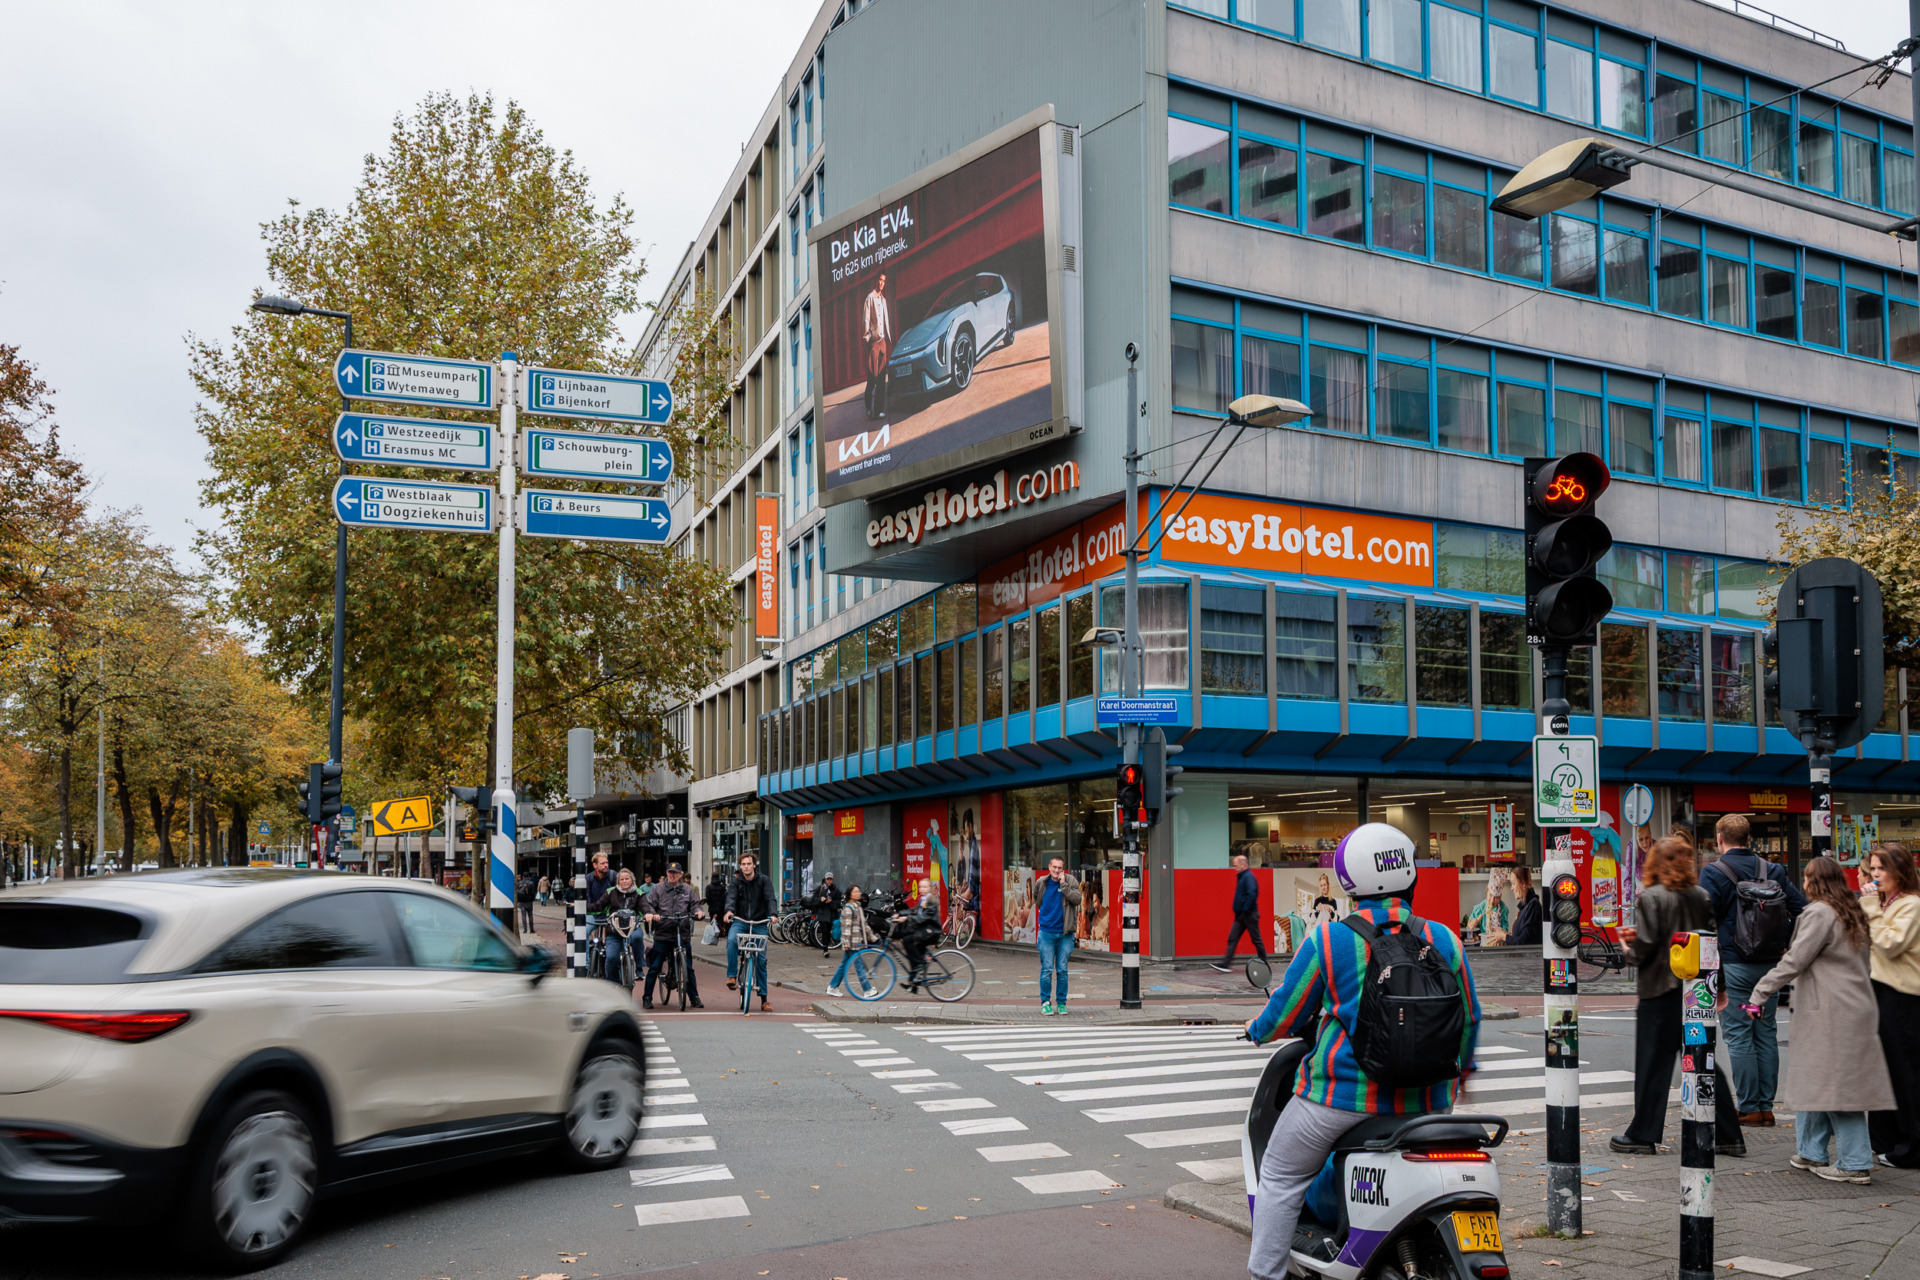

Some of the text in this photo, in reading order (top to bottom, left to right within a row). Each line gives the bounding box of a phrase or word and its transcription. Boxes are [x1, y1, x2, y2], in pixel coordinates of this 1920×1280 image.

[831, 205, 914, 264] De Kia EV4.
[831, 237, 908, 282] Tot 625 km rijbereik.
[402, 366, 478, 383] Museumpark
[387, 380, 459, 398] Wytemaweg
[558, 380, 606, 393] Lijnbaan
[558, 395, 611, 409] Bijenkorf
[387, 425, 462, 442] Westzeedijk
[1029, 425, 1053, 440] OCEAN
[383, 443, 434, 457] Erasmus
[438, 447, 456, 458] MC
[558, 440, 633, 458] Schouwburg-
[604, 461, 633, 471] plein
[839, 453, 891, 476] Movement that inspires
[387, 488, 452, 502] Westblaak
[866, 460, 1080, 547] easyHotel.com
[383, 505, 485, 523] Oogziekenhuis
[569, 501, 601, 513] Beurs
[1164, 511, 1430, 568] easyHotel.com
[758, 525, 775, 610] easyHotel
[992, 521, 1125, 607] easyHotel.com
[1100, 701, 1174, 709] Karel Doormanstraat
[1558, 773, 1576, 788] 70
[1749, 789, 1788, 805] wibra
[401, 806, 418, 824] A
[841, 811, 856, 829] wibra
[653, 819, 684, 835] SUGO
[1373, 847, 1410, 873] CHECK.
[1595, 880, 1612, 897] Dasty
[1350, 1165, 1389, 1207] CHECK.
[1468, 1215, 1493, 1230] FNT
